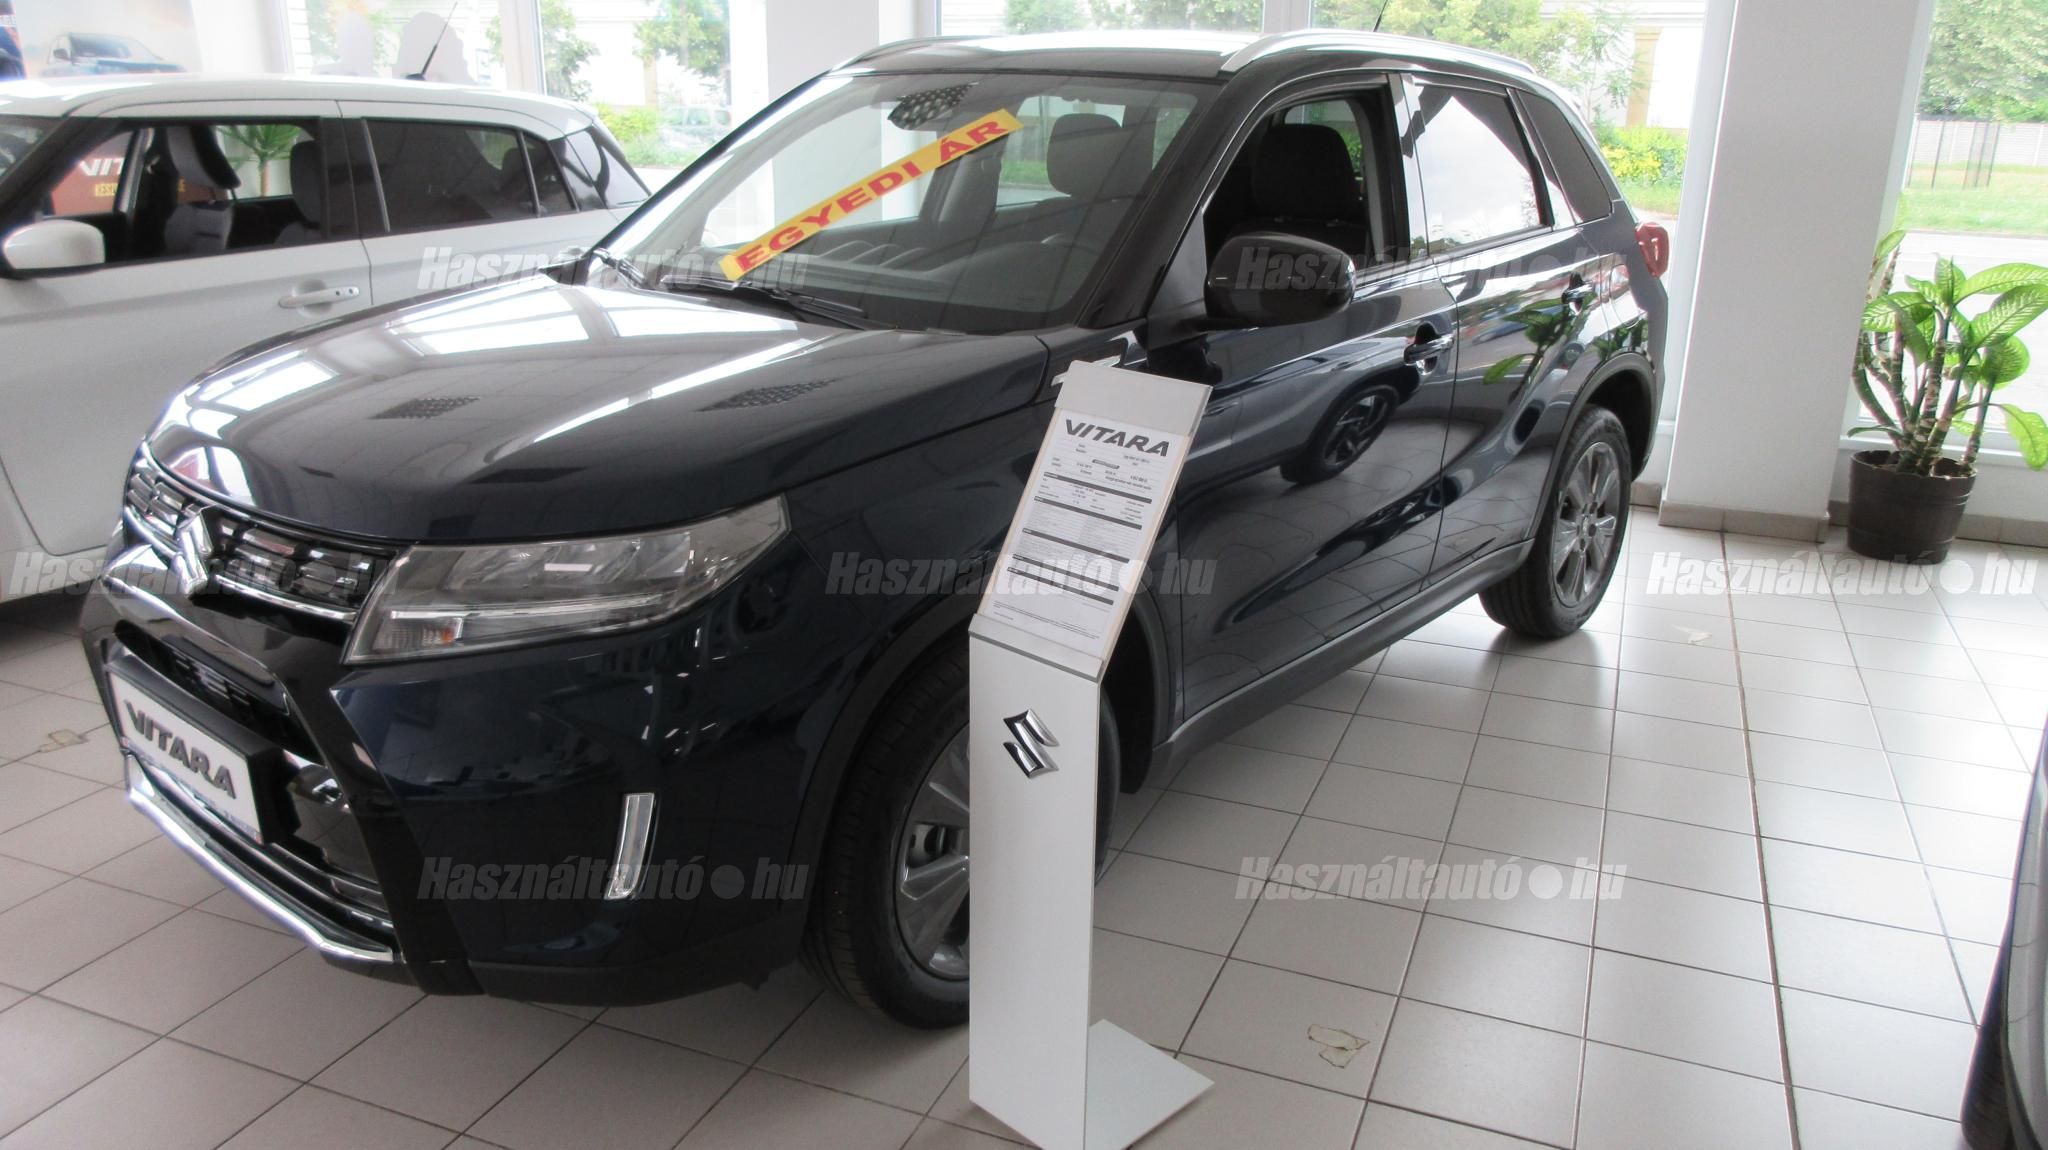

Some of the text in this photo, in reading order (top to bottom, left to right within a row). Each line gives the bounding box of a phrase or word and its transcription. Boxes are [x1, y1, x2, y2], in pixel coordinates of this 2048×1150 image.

[79, 157, 125, 176] VIT
[736, 120, 1009, 273] EGYEDI ÁR
[1065, 418, 1170, 457] VITARA
[124, 699, 237, 799] VITARA
